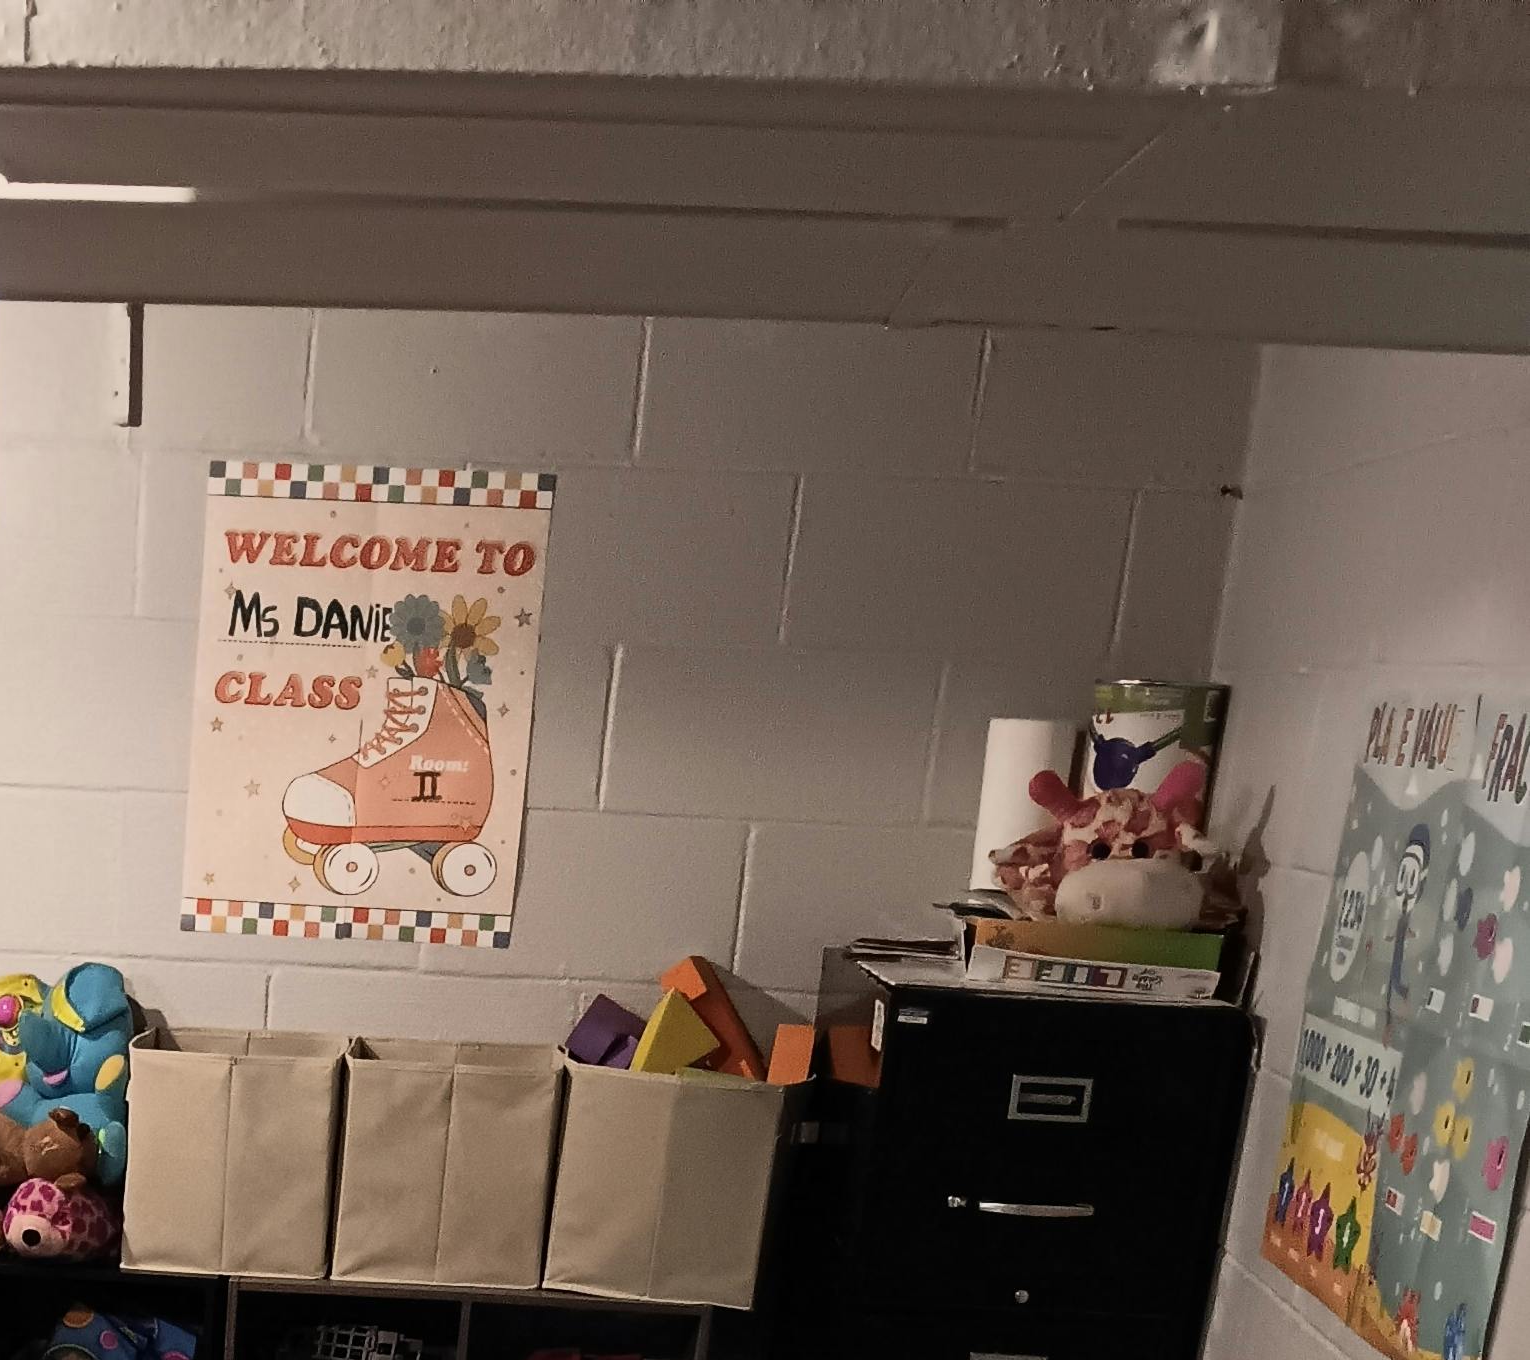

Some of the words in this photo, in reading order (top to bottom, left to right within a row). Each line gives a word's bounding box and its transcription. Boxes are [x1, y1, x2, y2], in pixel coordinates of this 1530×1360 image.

[225, 530, 462, 574] WELCOME
[476, 539, 536, 577] TO
[228, 589, 279, 637] Ms
[214, 671, 363, 710] CLASS
[1364, 702, 1415, 766] PLAE
